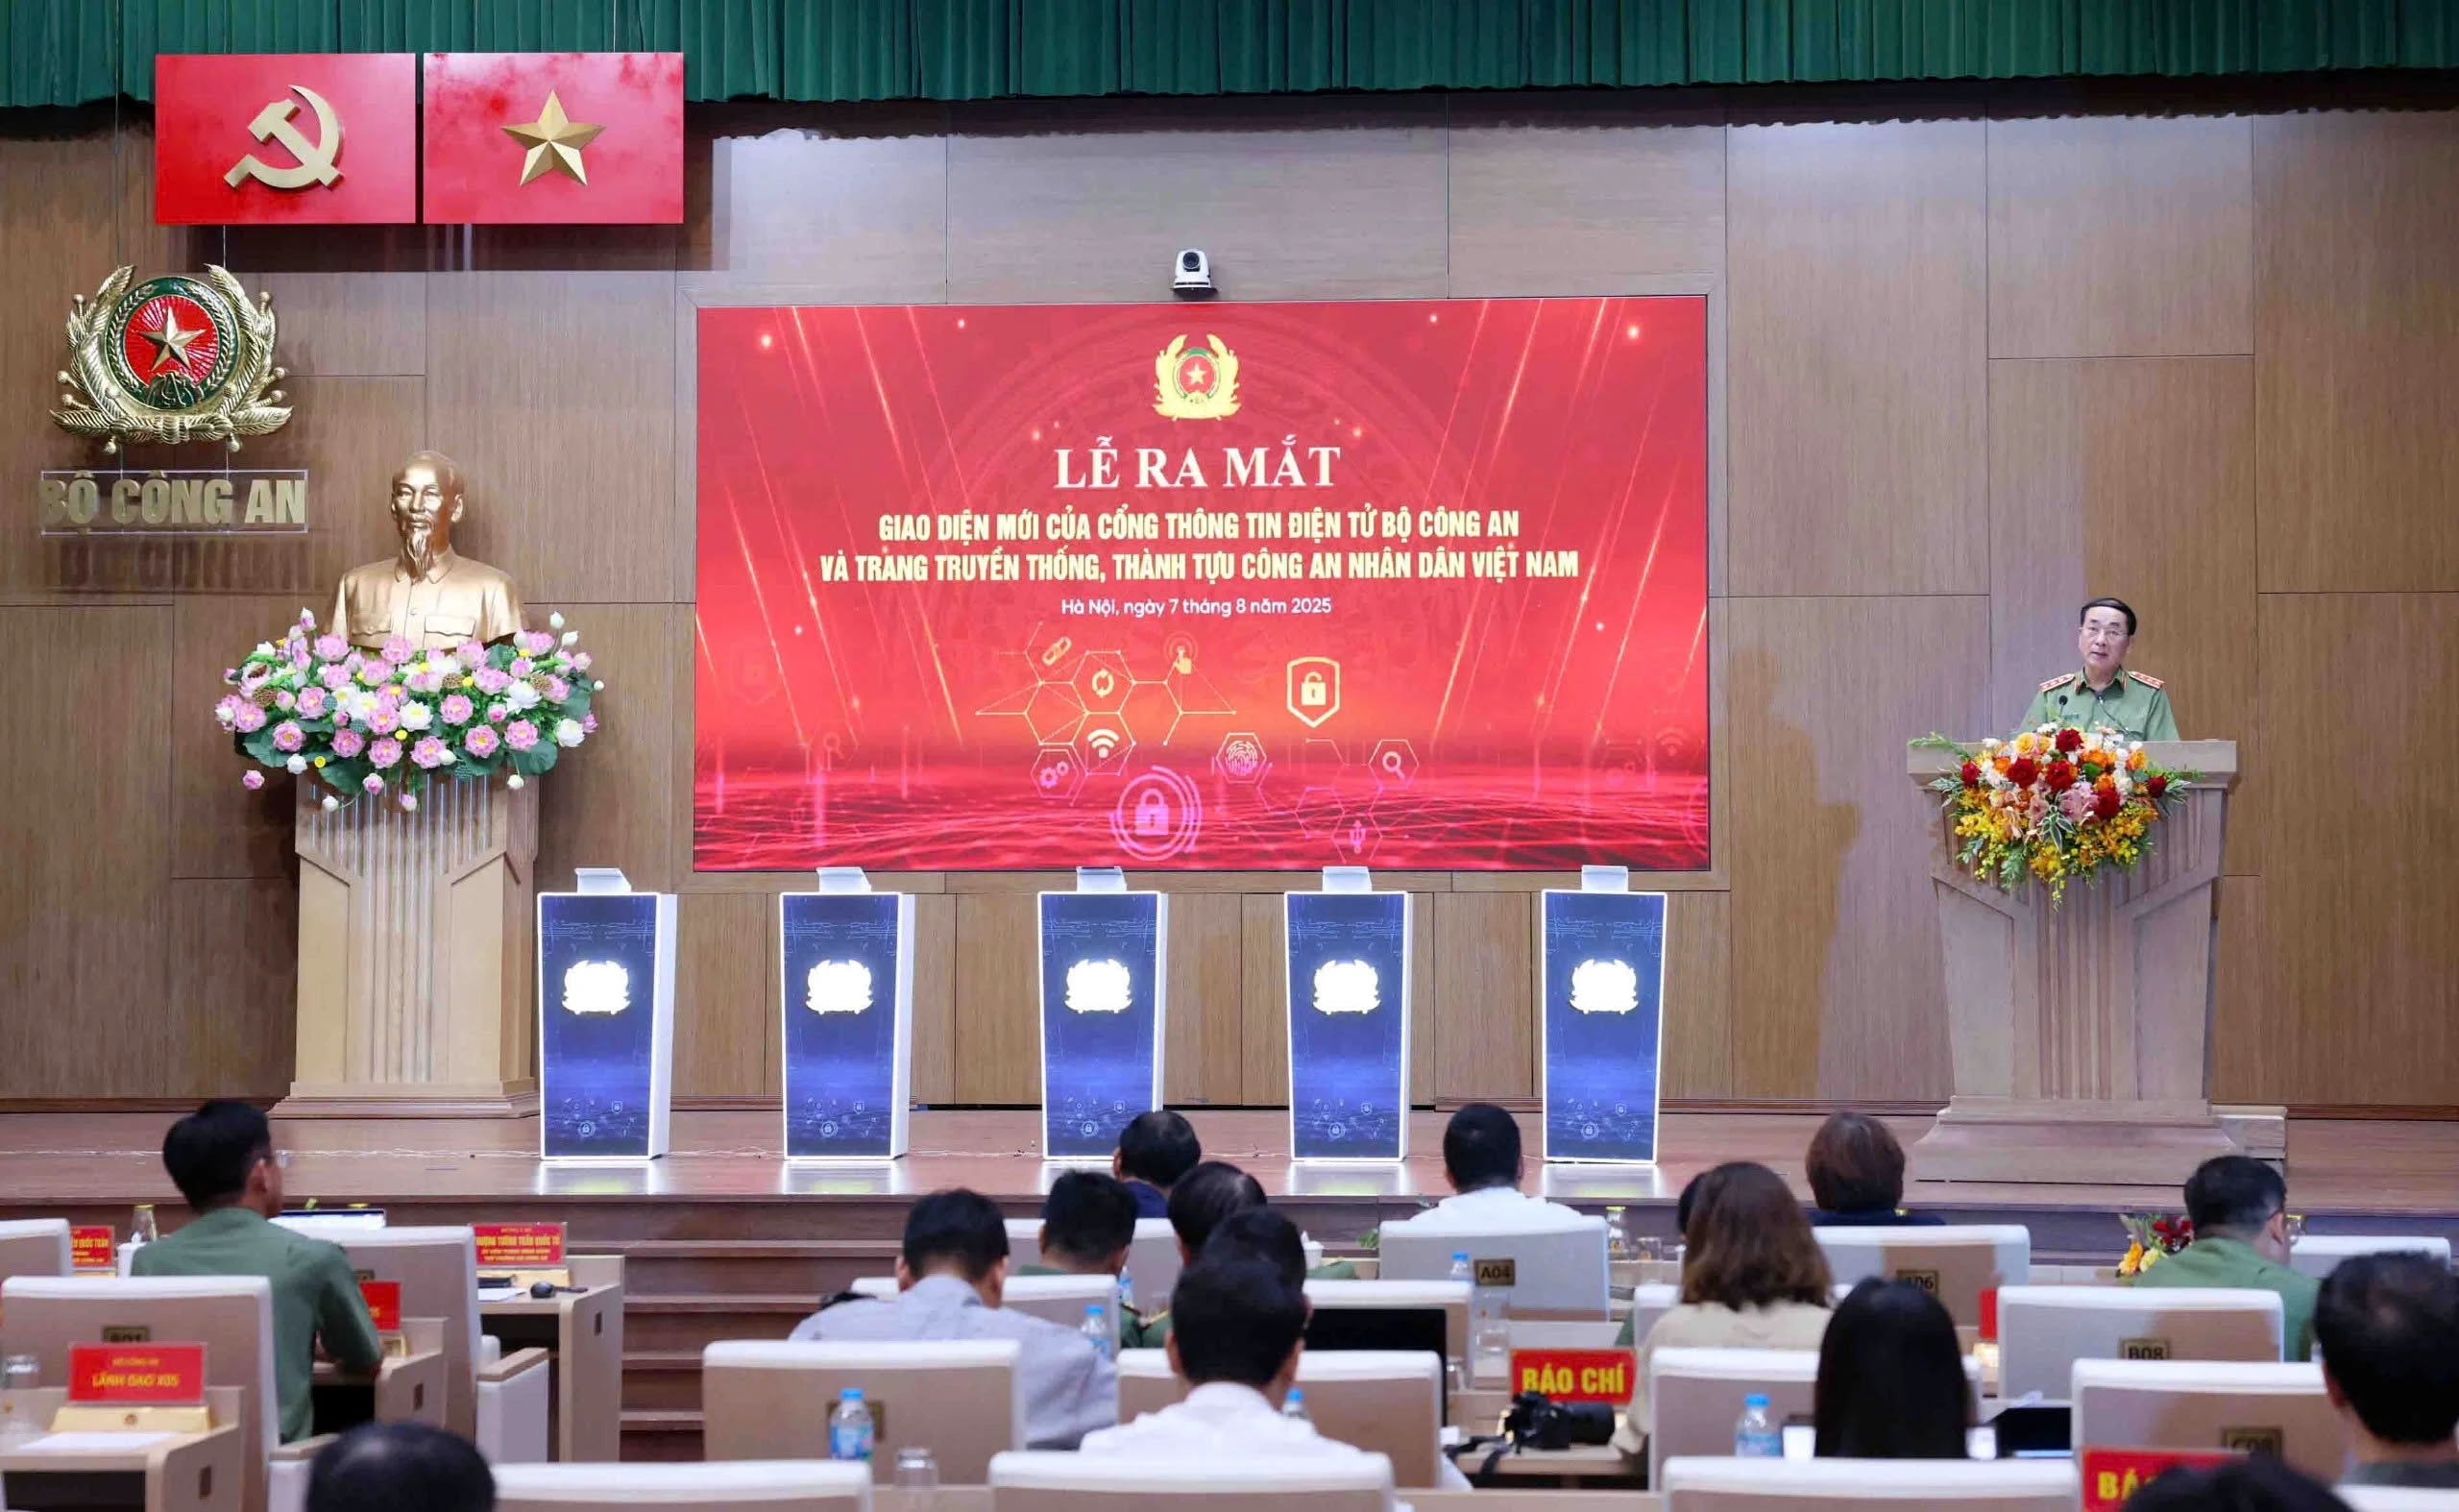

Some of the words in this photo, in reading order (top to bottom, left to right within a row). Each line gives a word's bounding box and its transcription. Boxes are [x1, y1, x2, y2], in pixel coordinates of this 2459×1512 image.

[1054, 435, 1120, 488] LỄ
[1134, 448, 1208, 488] RA
[1222, 433, 1342, 487] MẮT
[40, 470, 98, 535] BỘ
[111, 470, 232, 524] CÔNG
[244, 479, 306, 524] AN
[879, 514, 931, 541] GIAO
[937, 509, 989, 547] DIỆN
[996, 508, 1039, 541] MỚI
[1046, 504, 1091, 540] CỦA
[1097, 503, 1159, 540] CỔNG
[1165, 507, 1239, 539] THÔNG
[1246, 512, 1282, 539] TIN
[1288, 506, 1342, 544] ĐIỆN
[1348, 502, 1377, 538] TỬ
[1381, 505, 1412, 543] BỘ
[1419, 505, 1481, 537] CÔNG
[1487, 510, 1520, 537] AN
[820, 549, 850, 582] VÀ
[855, 554, 929, 582] TRANG
[1026, 545, 1106, 583] THỐNG,
[1112, 547, 1186, 580] THÀNH
[1192, 550, 1235, 585] TỰU
[1241, 547, 1303, 580] CÔNG
[1309, 552, 1342, 578] AN
[1348, 546, 1411, 579] NHÂN
[1418, 546, 1466, 578] DÂN
[1472, 545, 1521, 583] VIỆT
[1525, 551, 1579, 577] NAM
[1061, 598, 1084, 615] Hà
[1088, 598, 1119, 618] Nội,
[1124, 600, 1164, 618] ngày
[1169, 598, 1179, 615] 7
[1182, 597, 1231, 618] tháng
[1236, 598, 1247, 614] 8
[1251, 598, 1287, 614] năm
[1291, 597, 1332, 614] 2025
[1480, 1267, 1511, 1280] A04
[1522, 1362, 1573, 1394] BÁO
[1580, 1362, 1625, 1394] CHÍ
